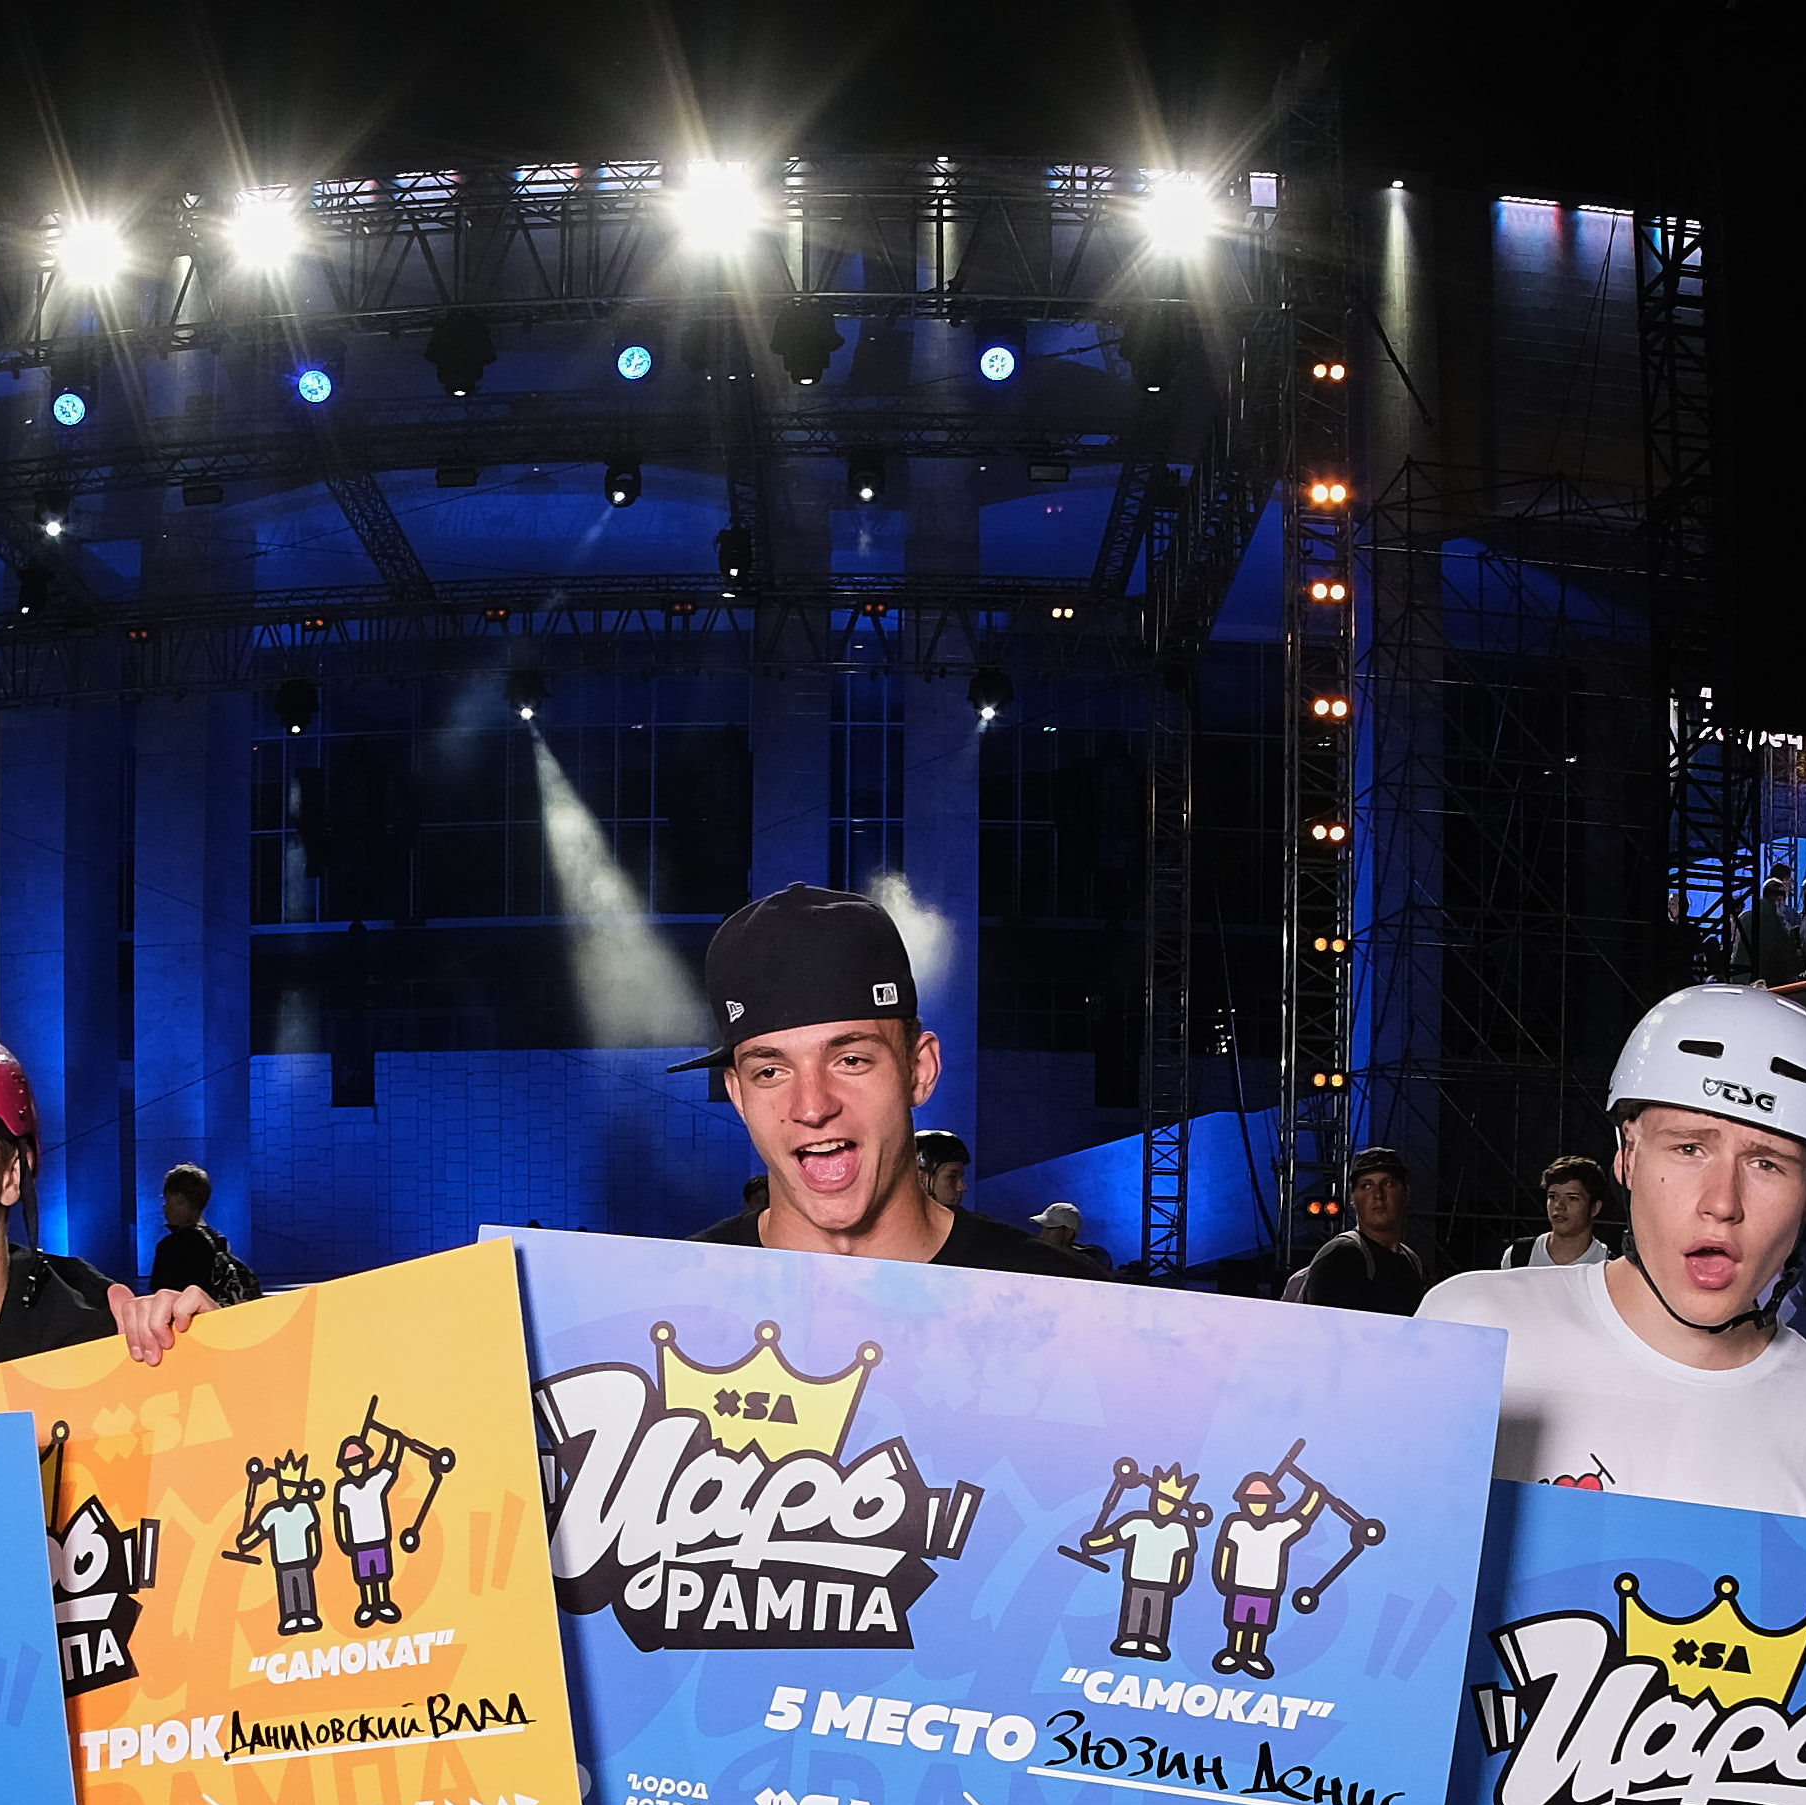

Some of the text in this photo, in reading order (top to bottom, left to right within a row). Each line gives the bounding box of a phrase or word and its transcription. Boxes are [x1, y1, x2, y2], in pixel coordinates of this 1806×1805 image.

[664, 1572, 899, 1633] РАМПА
[78, 1714, 226, 1771] ТРЮК
[764, 1686, 1037, 1763] 5 МЕСТО
